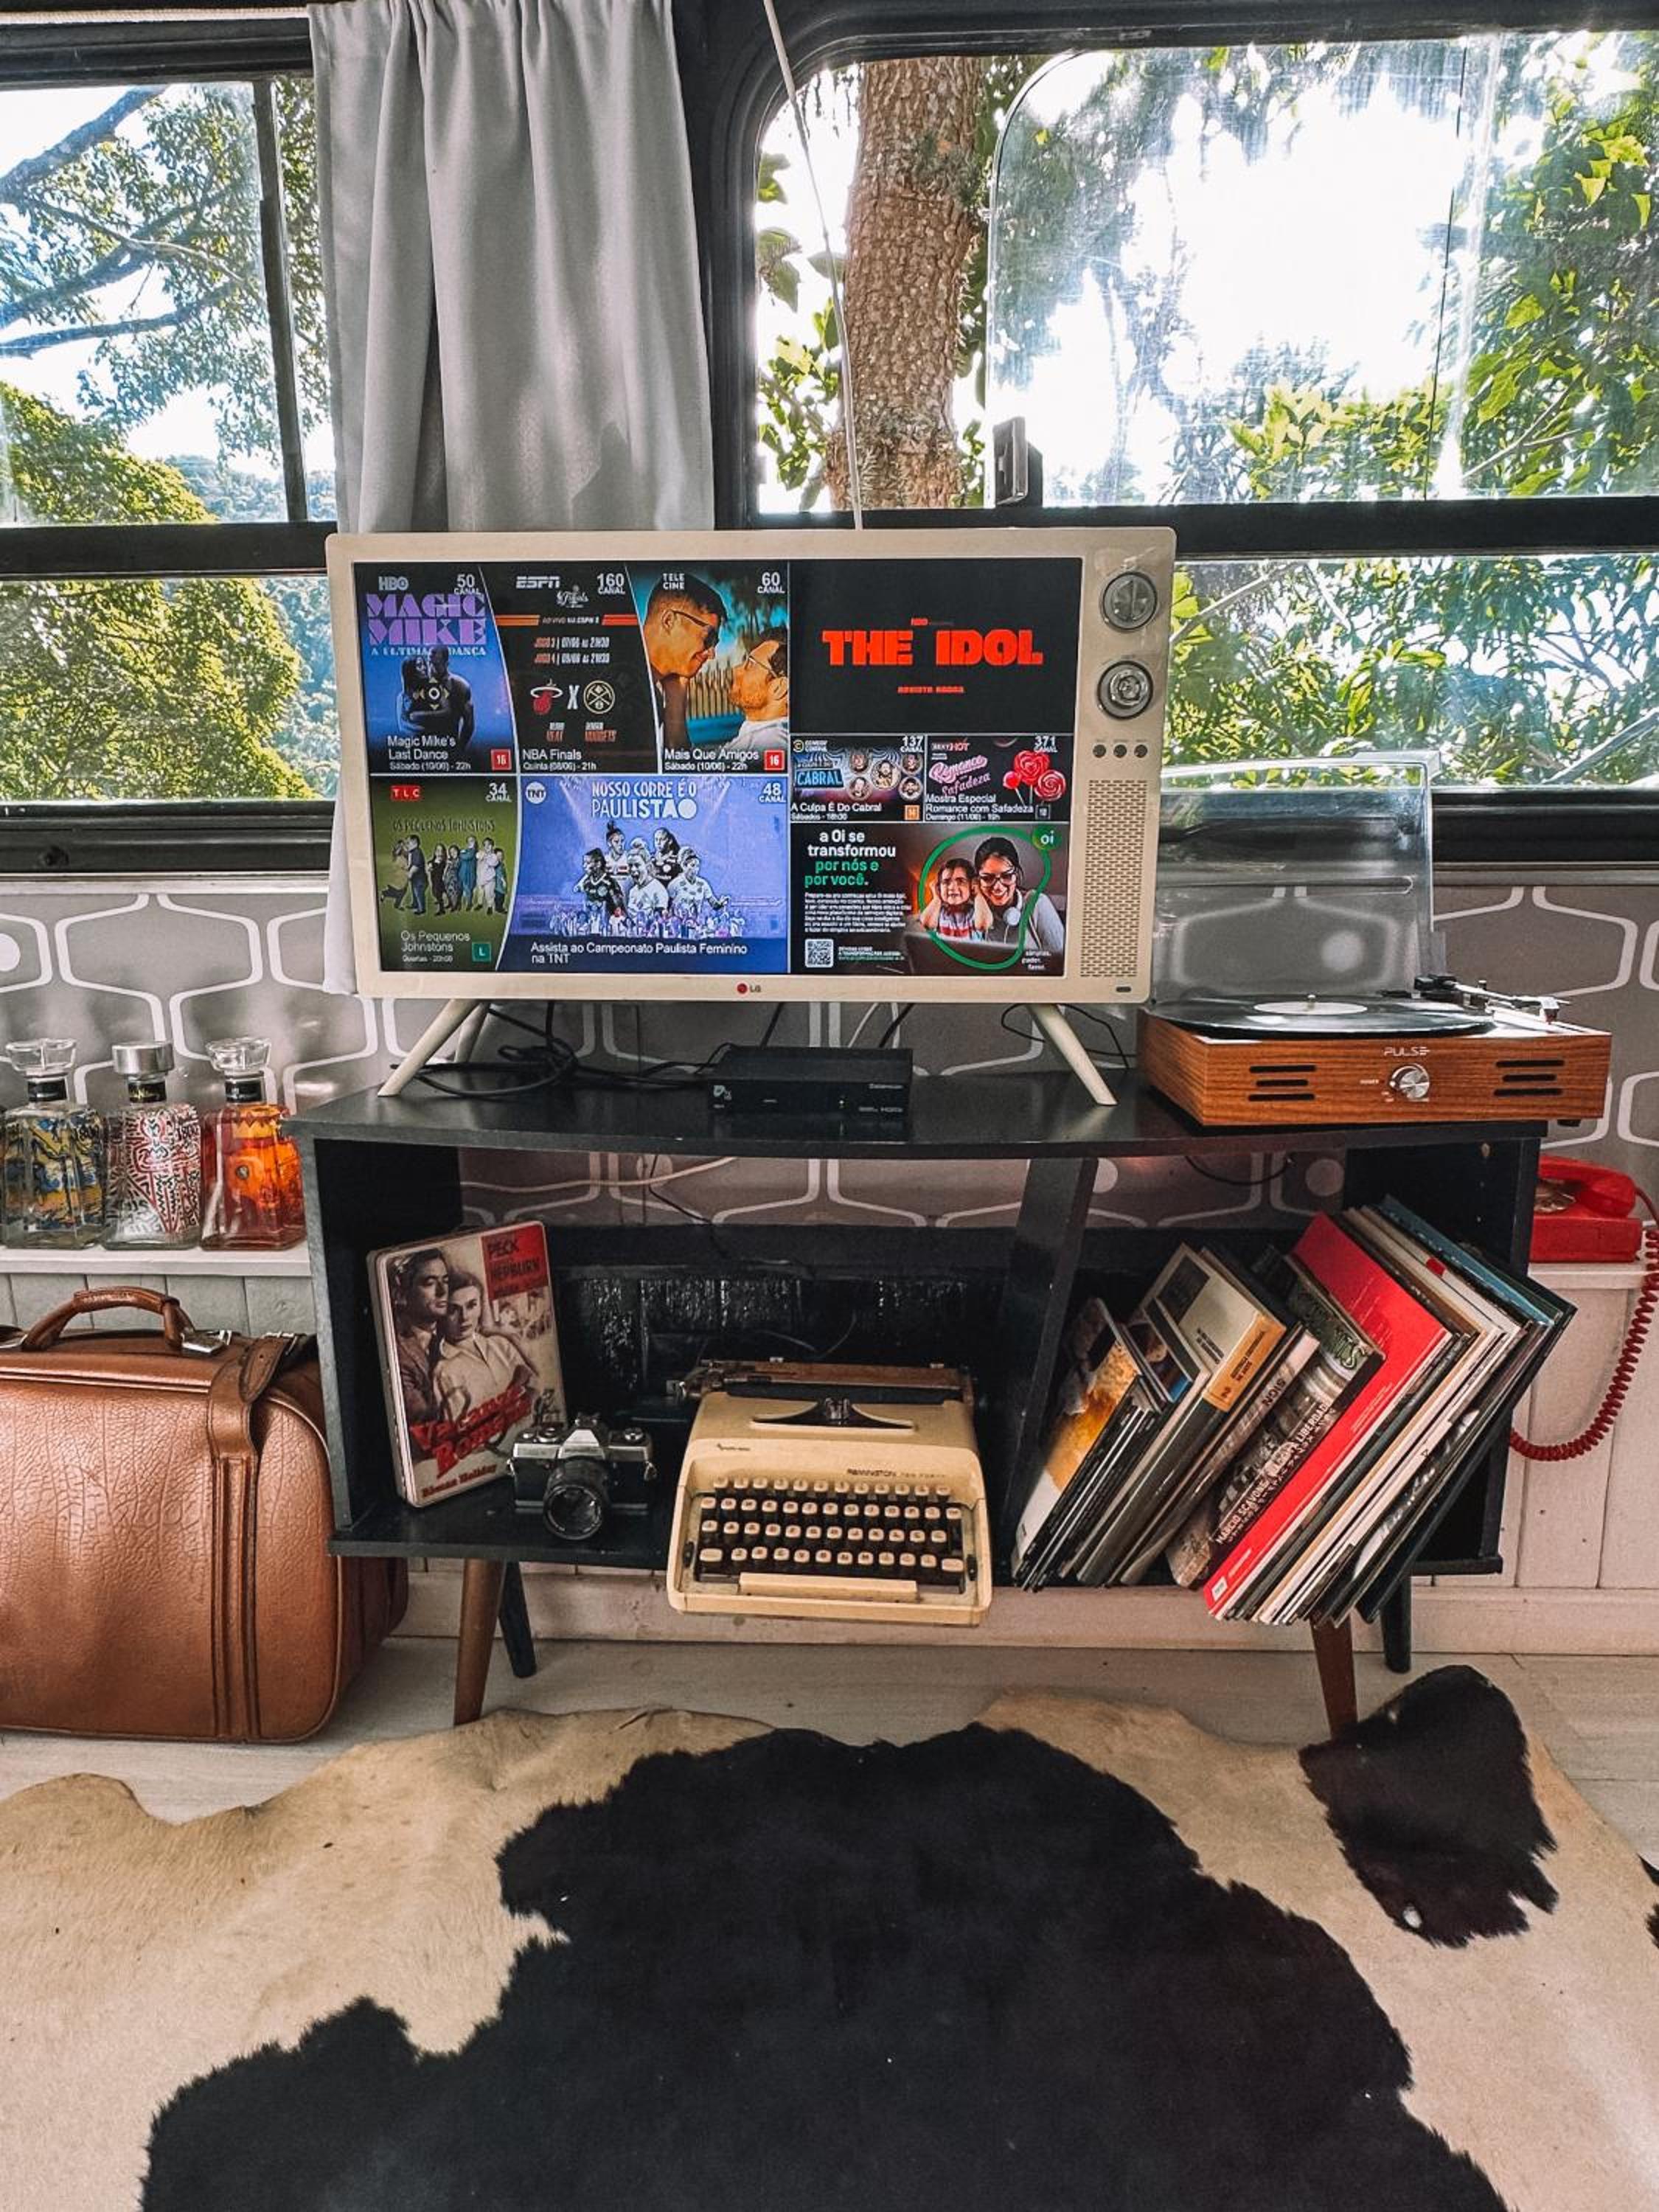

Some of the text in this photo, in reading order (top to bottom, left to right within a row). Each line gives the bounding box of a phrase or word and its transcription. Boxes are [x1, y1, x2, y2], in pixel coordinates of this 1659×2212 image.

[378, 576, 408, 591] HBO
[456, 574, 475, 588] 50
[516, 576, 560, 588] ESPN
[597, 573, 625, 588] 160
[663, 573, 685, 582] TELE
[762, 572, 780, 586] 60
[663, 582, 685, 590] CINE
[366, 593, 485, 617] MAGIC
[368, 619, 487, 645] MIKE
[822, 629, 1044, 666] THE IDOL
[387, 735, 456, 748] Magic Mike's
[902, 736, 923, 746] 137
[389, 748, 448, 760] Last Dance
[522, 749, 582, 760] NBA Finals
[664, 748, 759, 762] Mais Que Amigos
[582, 762, 597, 771] 21h
[665, 762, 695, 771] Sábado
[731, 762, 748, 771] 22h
[797, 771, 843, 786] CABRAL
[489, 783, 508, 796] 34
[527, 789, 546, 798] TNT
[592, 776, 697, 798] NOSSO CORRE É O
[762, 782, 782, 796] 48
[925, 793, 996, 804] Mostra Especial
[791, 803, 799, 811] A
[800, 803, 826, 813] Culpa
[837, 804, 849, 812] Do
[852, 803, 882, 812] Cabral
[992, 804, 1033, 813] Safadeza
[819, 830, 865, 842] a Oi se
[1040, 831, 1054, 844] oi
[807, 844, 897, 857] transformou
[815, 858, 879, 873] por nós e
[804, 873, 869, 888] por você.
[401, 931, 471, 942] Os Pequenos
[401, 942, 453, 952] Johnstons
[530, 942, 747, 956] Assista ao Campeonato Paulista Feminino
[532, 953, 570, 964] na TNT
[1383, 1046, 1431, 1057] PULSE
